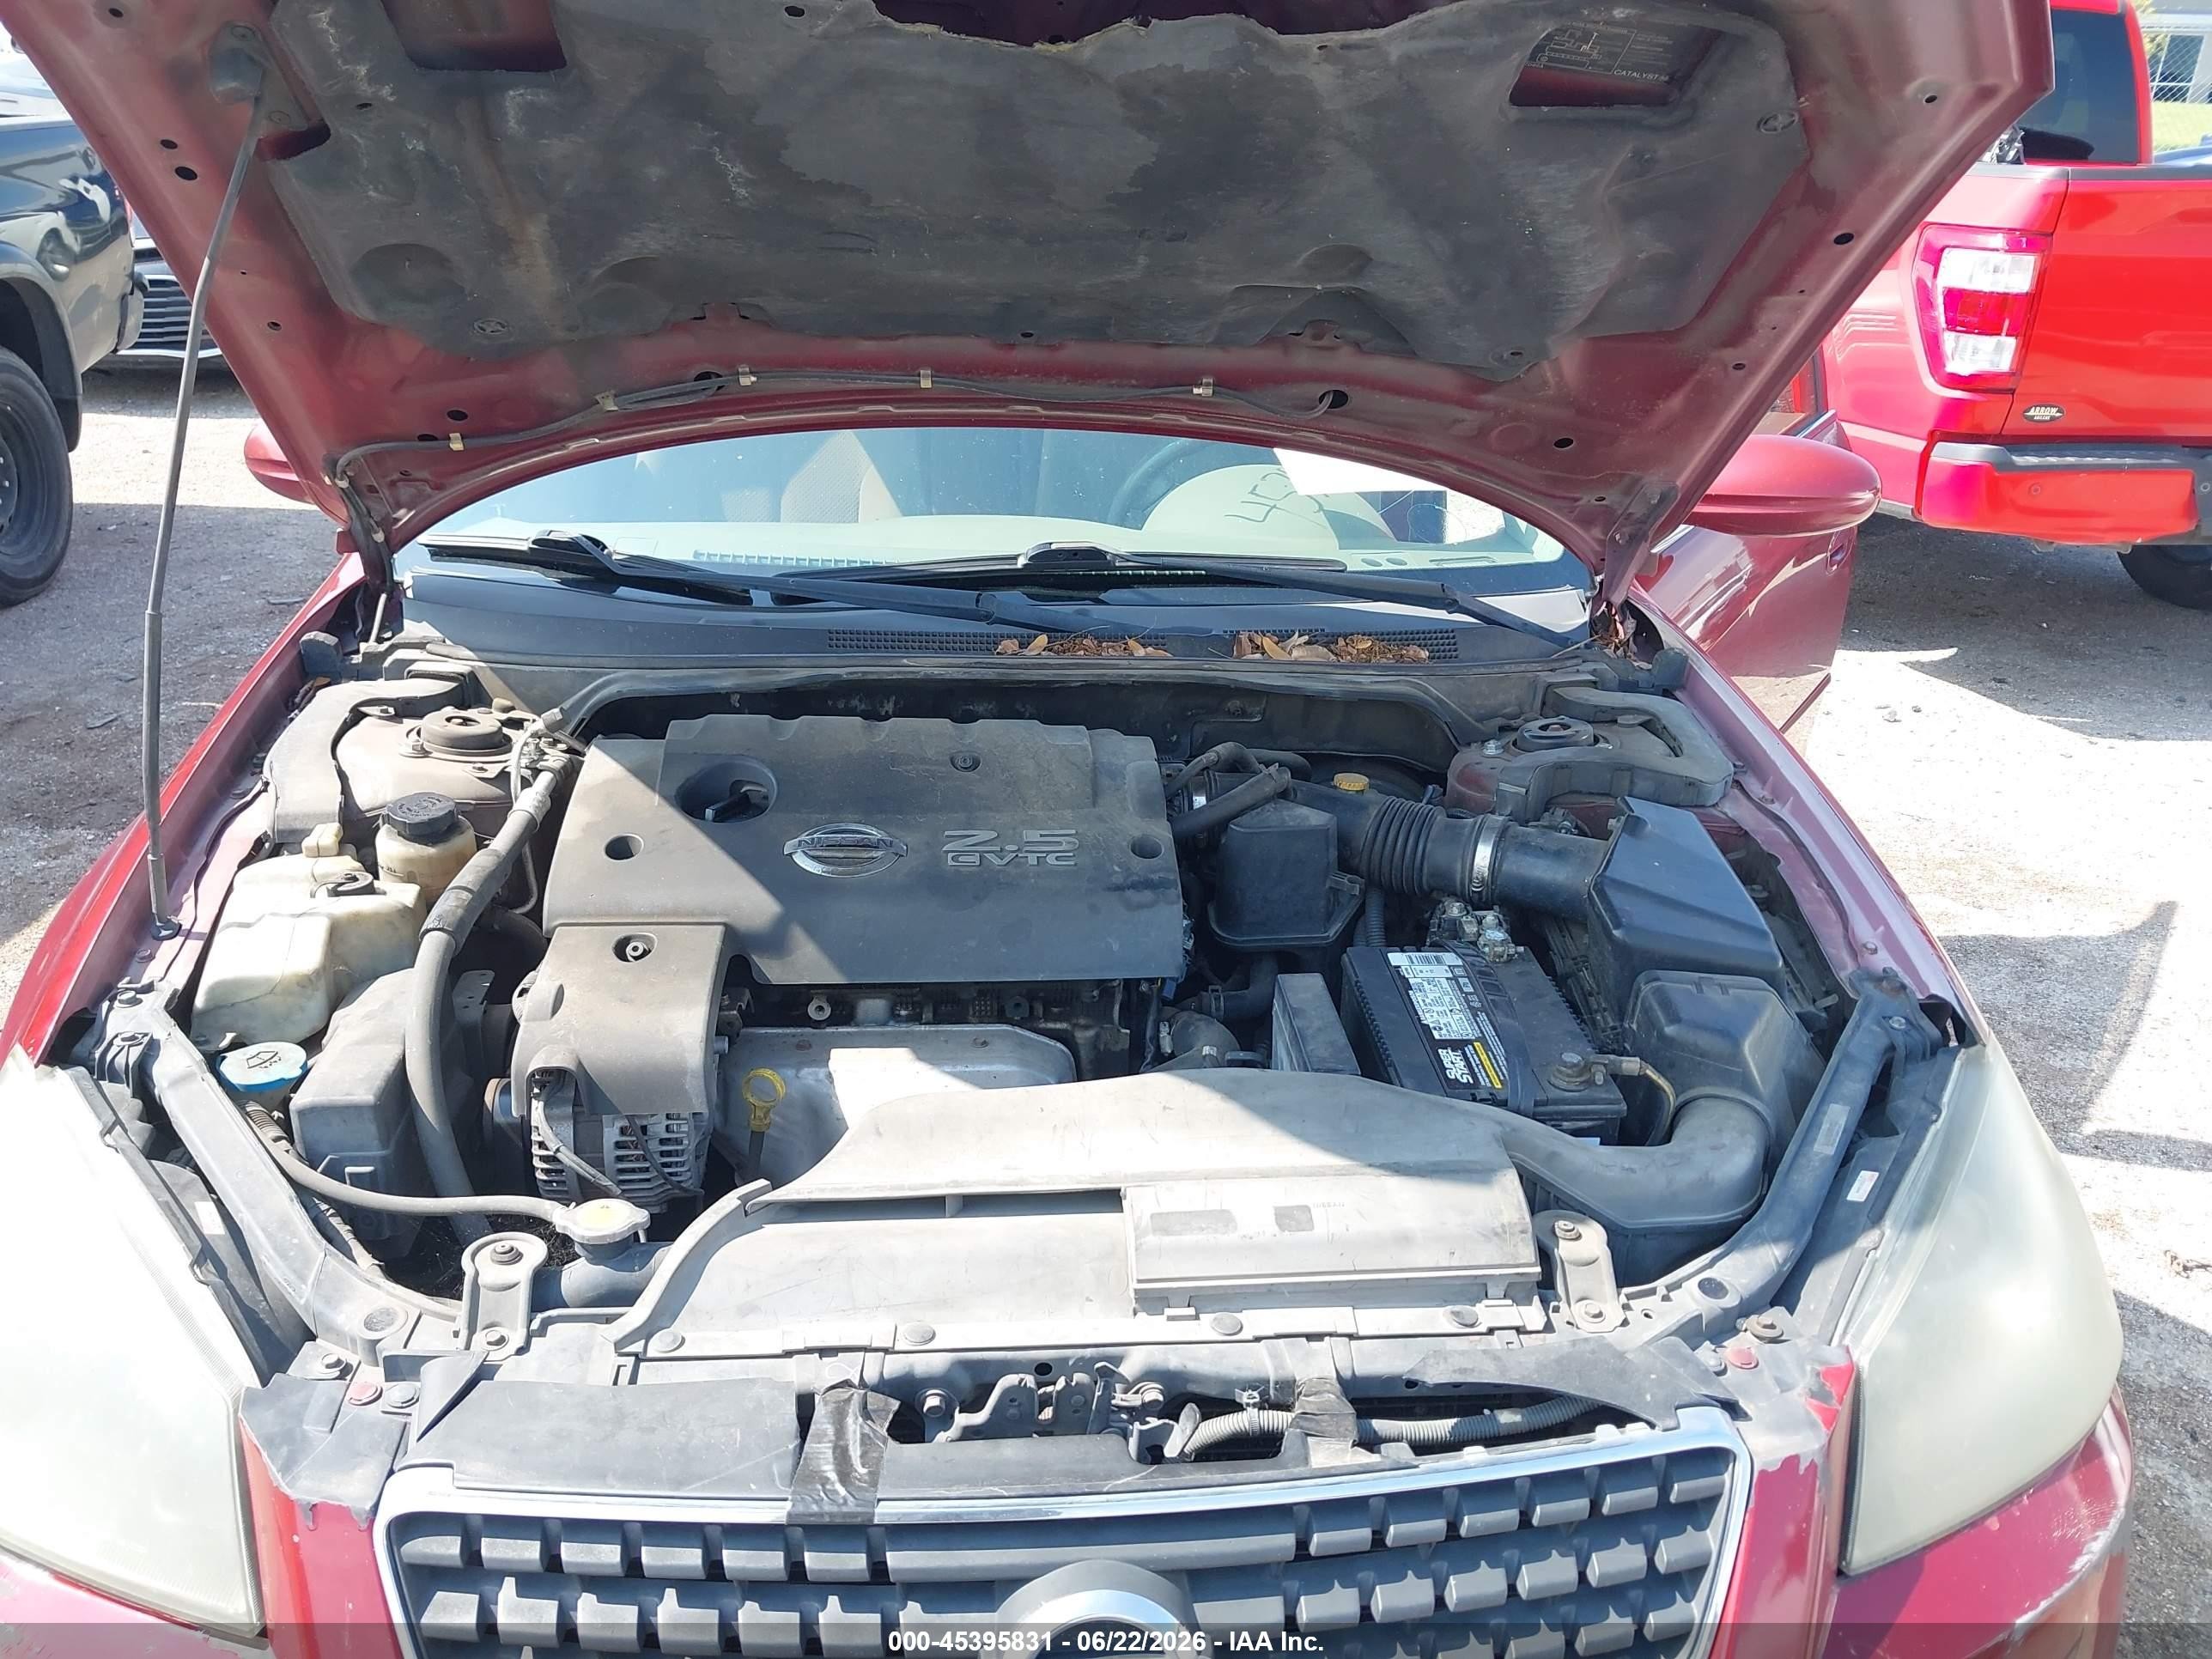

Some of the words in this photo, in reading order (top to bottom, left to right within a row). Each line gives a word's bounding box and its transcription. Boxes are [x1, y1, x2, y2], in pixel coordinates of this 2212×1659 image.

[1613, 69, 1659, 80] CATALYST
[2029, 406, 2059, 415] ARROW
[797, 836, 894, 848] NISSAN
[942, 830, 1079, 852] 2.5
[1437, 1048, 1455, 1079] SUPER
[1449, 1048, 1474, 1084] START
